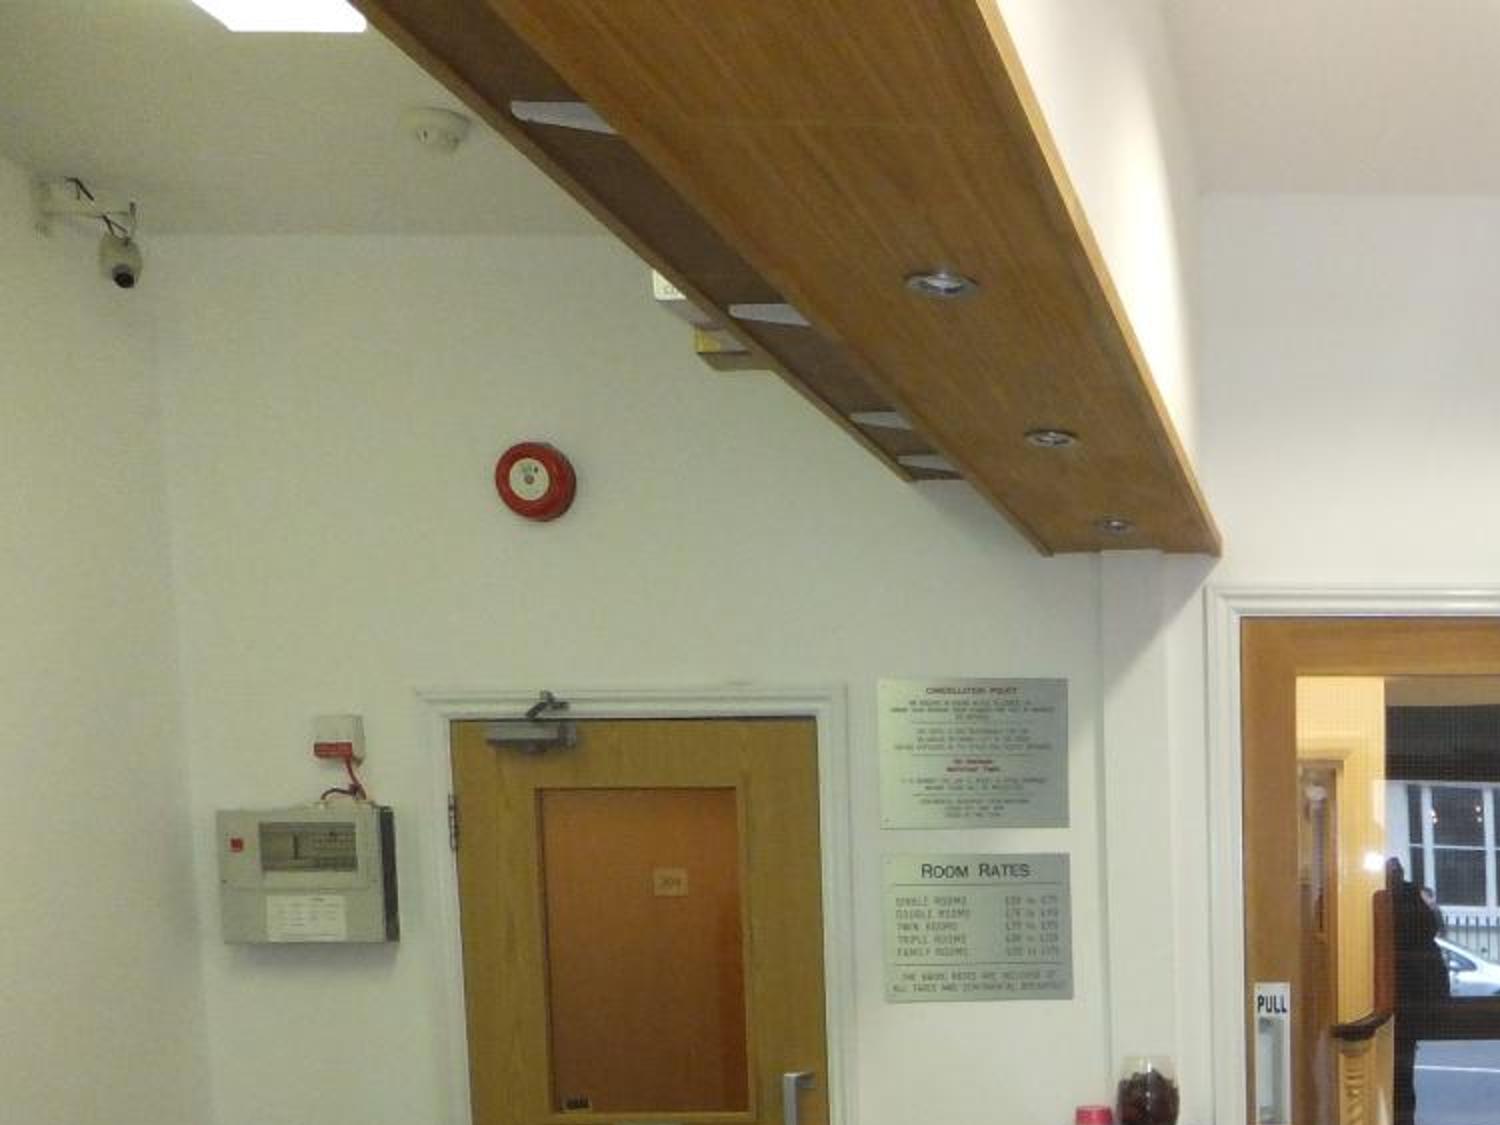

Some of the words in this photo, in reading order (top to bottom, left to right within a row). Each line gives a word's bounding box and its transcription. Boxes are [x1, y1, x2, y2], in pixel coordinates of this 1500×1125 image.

[921, 863, 969, 879] ROOM
[979, 862, 1031, 878] RATES
[1257, 994, 1287, 1013] PULL
